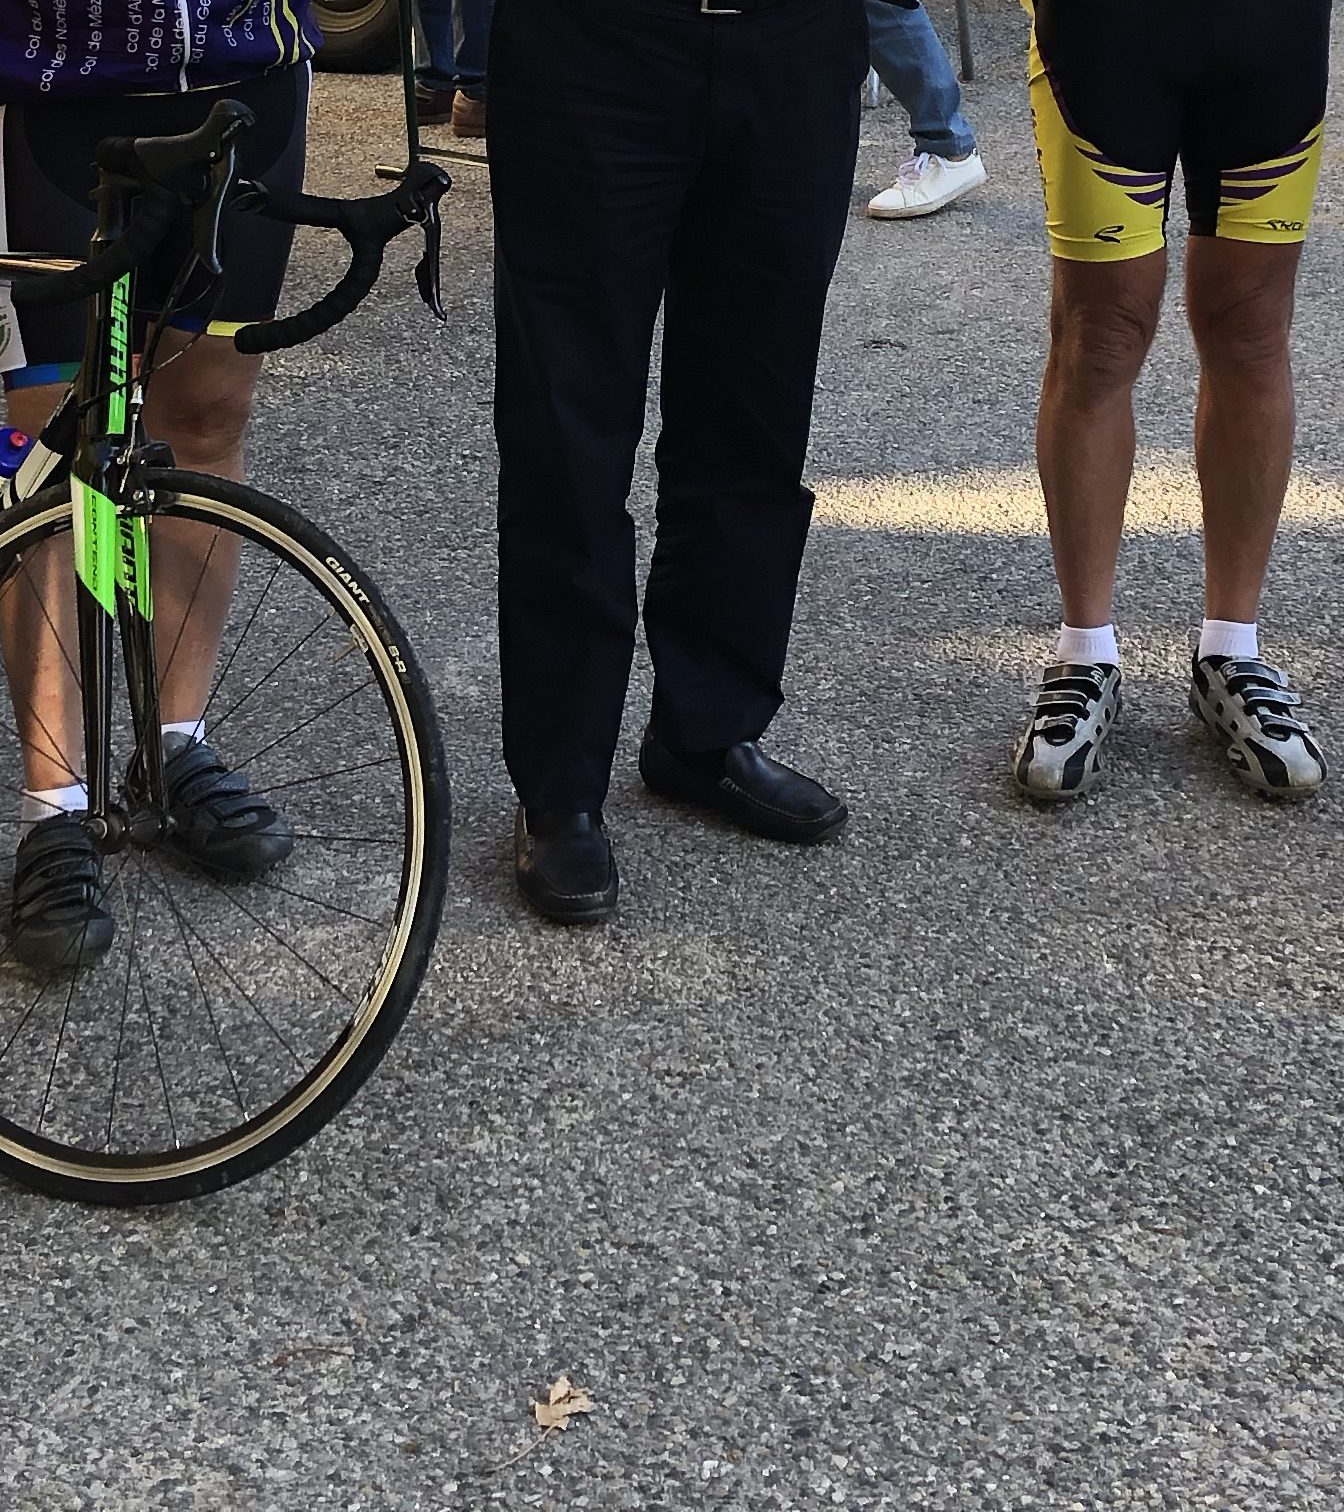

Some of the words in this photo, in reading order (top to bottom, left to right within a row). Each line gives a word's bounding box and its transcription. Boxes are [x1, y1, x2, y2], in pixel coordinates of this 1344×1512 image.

[88, 31, 103, 52] de
[127, 28, 142, 53] col
[149, 29, 164, 50] de
[195, 19, 208, 46] du
[25, 34, 40, 59] col
[325, 556, 371, 604] GIANT
